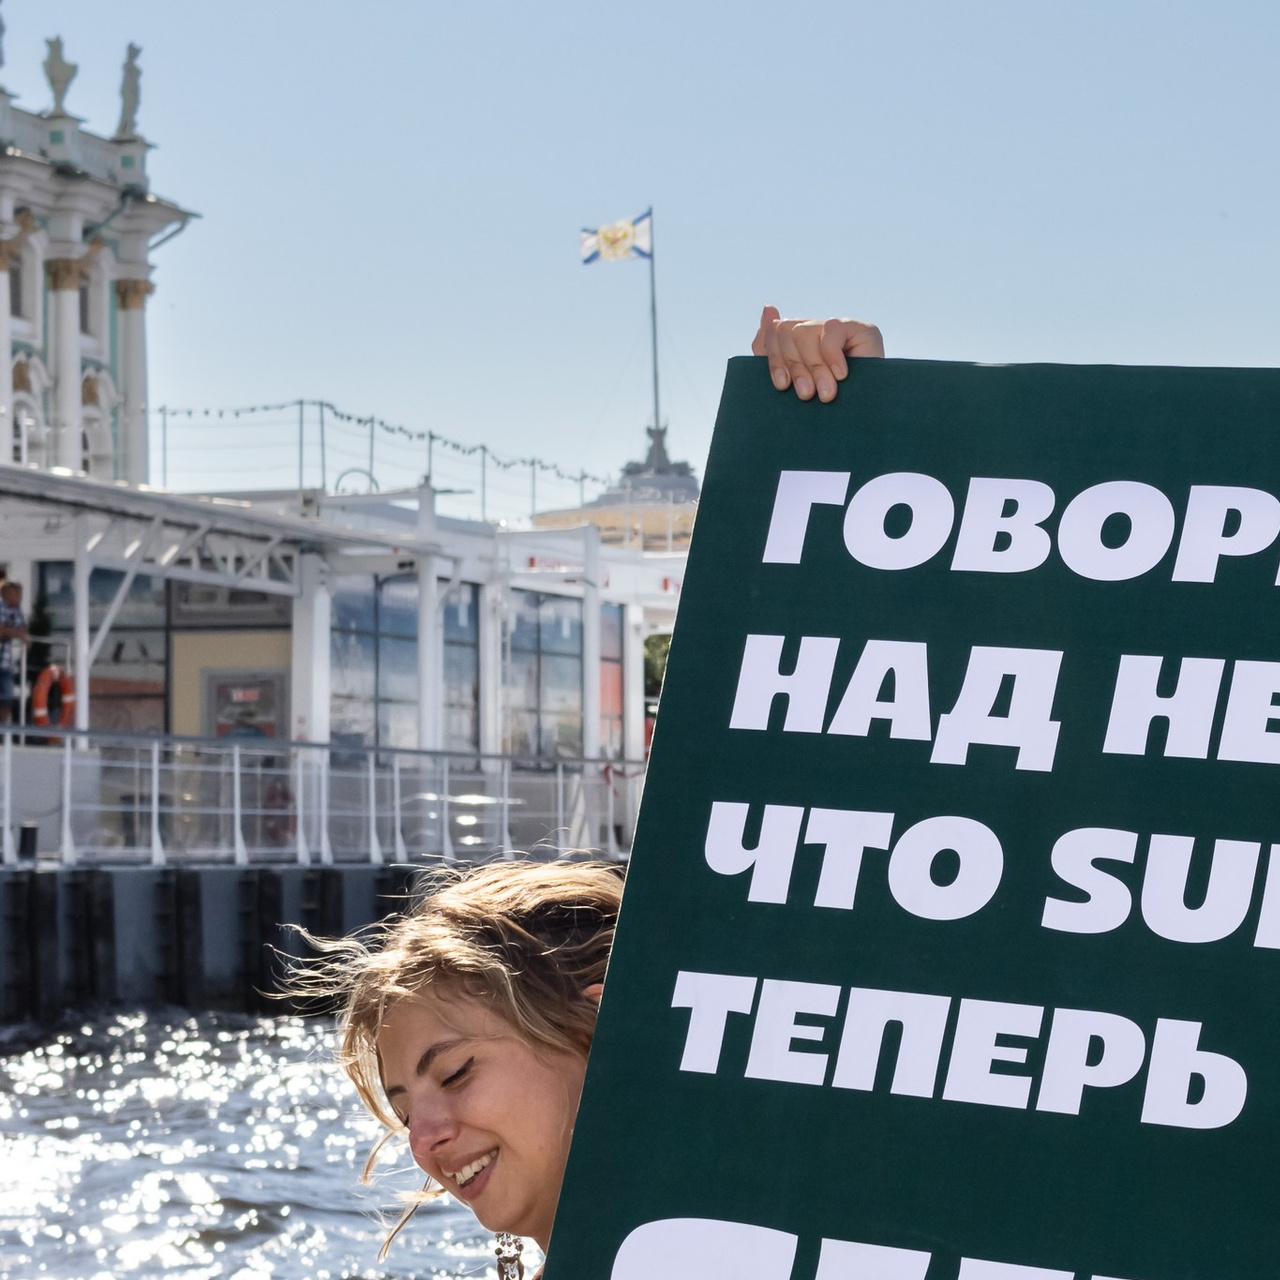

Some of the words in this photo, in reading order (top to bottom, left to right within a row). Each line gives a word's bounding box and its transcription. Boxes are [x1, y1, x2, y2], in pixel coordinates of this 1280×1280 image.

[728, 633, 1065, 773] НАД
[703, 801, 1004, 921] ЧТО
[670, 970, 1249, 1130] ТЕПЕРЬ
